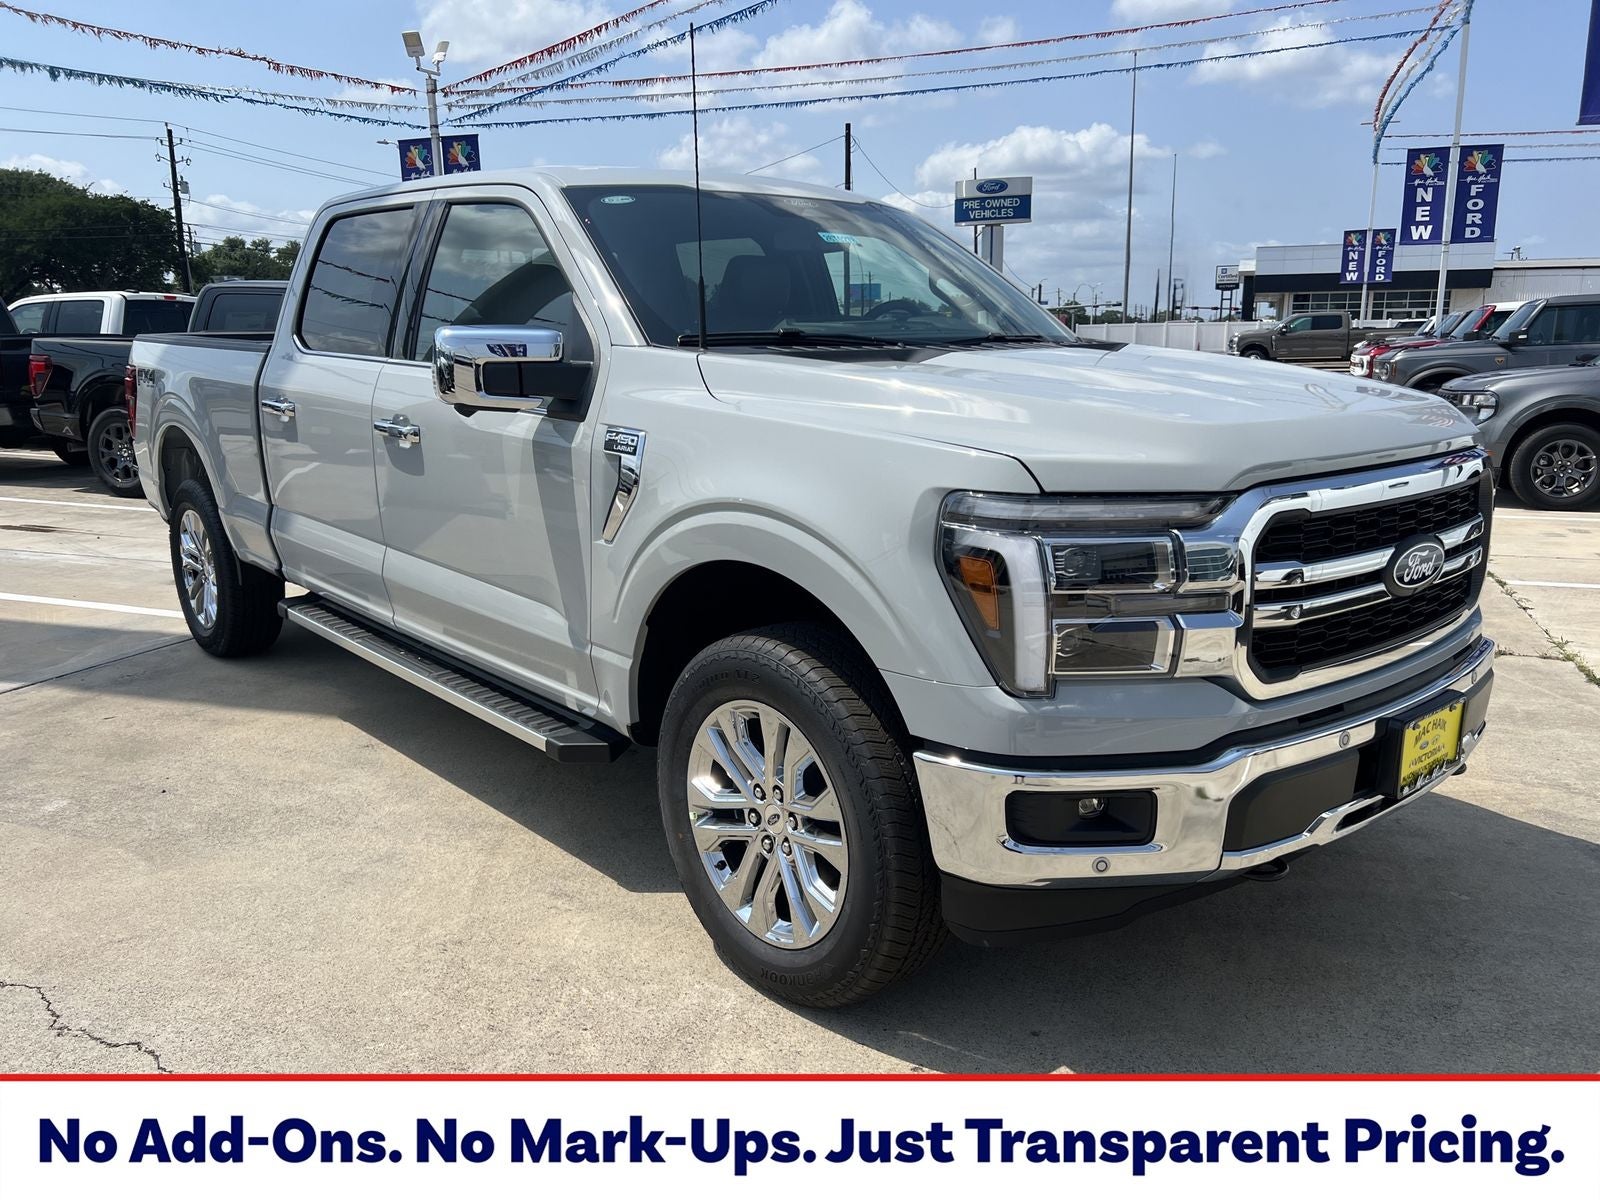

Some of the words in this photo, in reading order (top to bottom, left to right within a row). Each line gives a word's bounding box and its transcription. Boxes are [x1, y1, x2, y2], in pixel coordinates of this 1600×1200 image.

[982, 182, 1000, 191] Ford
[969, 208, 1014, 219] VEHICLES
[1410, 187, 1433, 240] NEW
[1465, 184, 1485, 238] FORD
[1345, 251, 1359, 281] NEW
[1375, 250, 1386, 281] FORD
[613, 444, 635, 452] LARIAT
[1403, 550, 1437, 583] Ford
